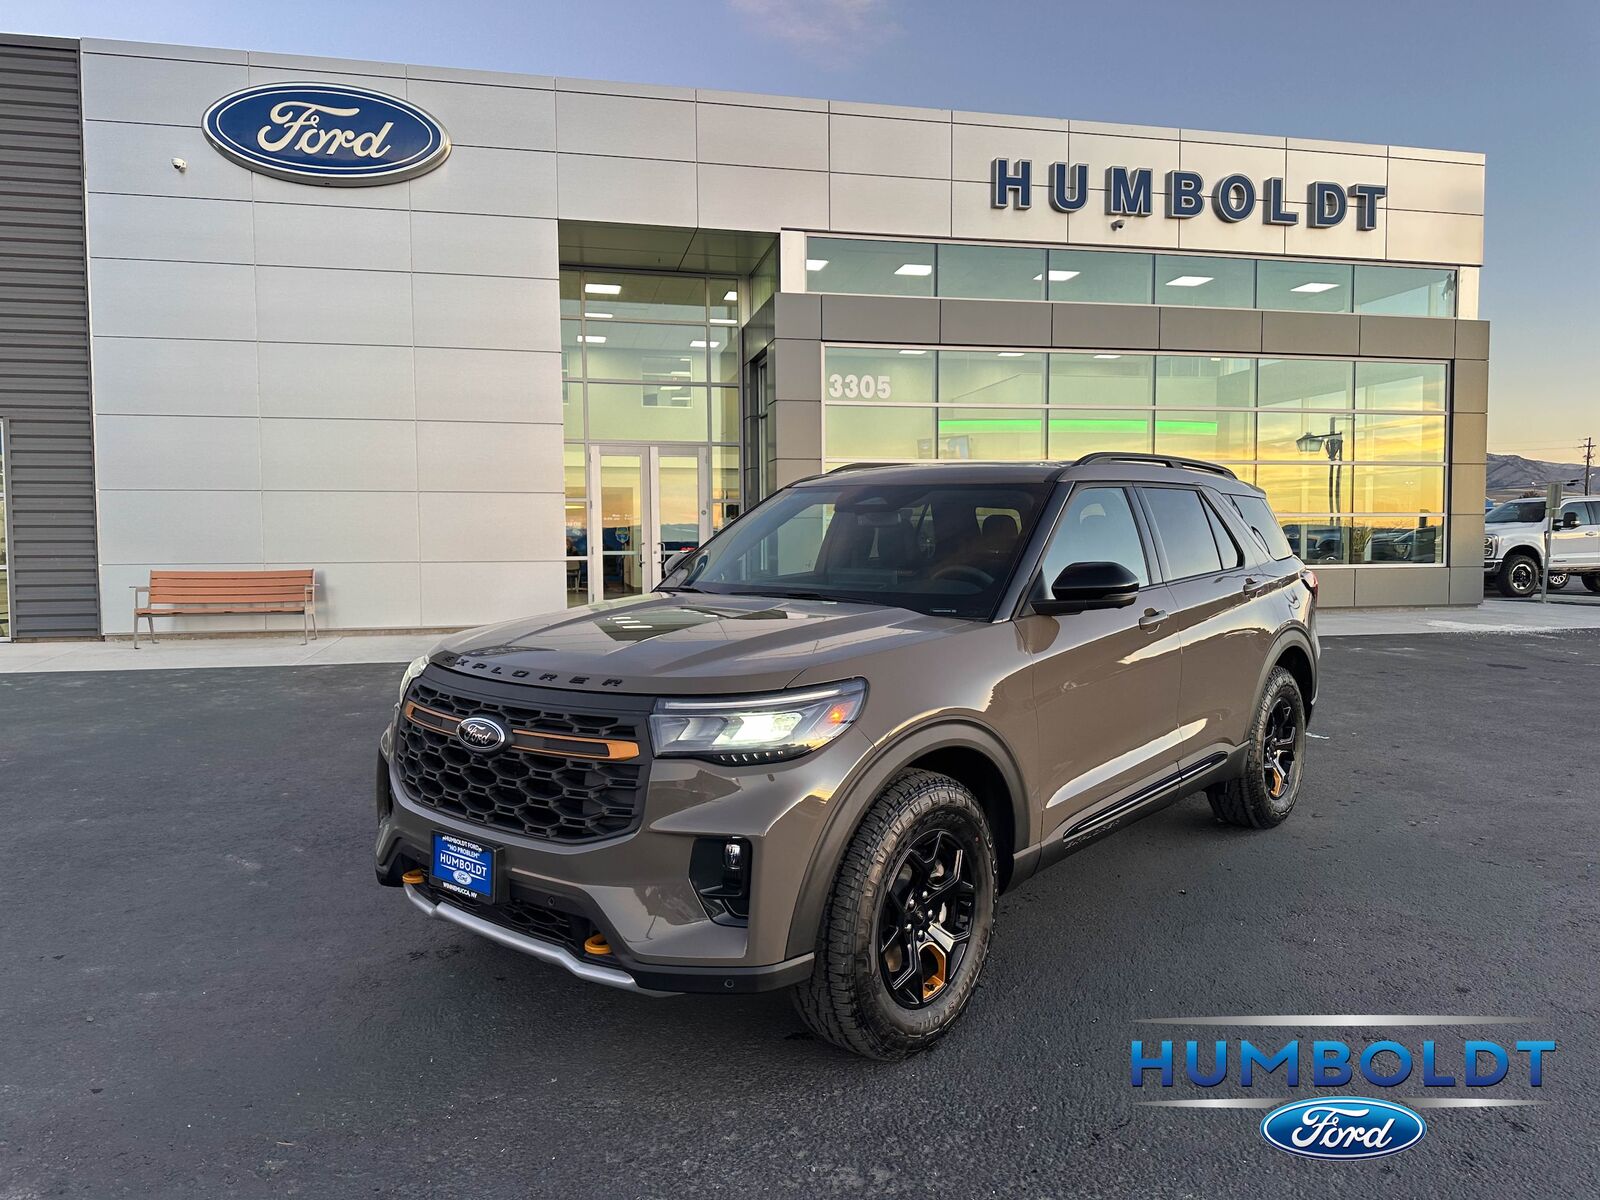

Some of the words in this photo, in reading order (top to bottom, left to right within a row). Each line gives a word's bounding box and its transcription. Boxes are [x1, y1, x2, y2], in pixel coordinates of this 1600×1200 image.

[257, 101, 394, 158] Ford
[990, 157, 1388, 231] HUMBOLDT
[828, 374, 891, 399] 3305
[442, 655, 623, 687] EXPLORER
[464, 724, 491, 744] Ford
[440, 852, 487, 877] HUMBOLDT
